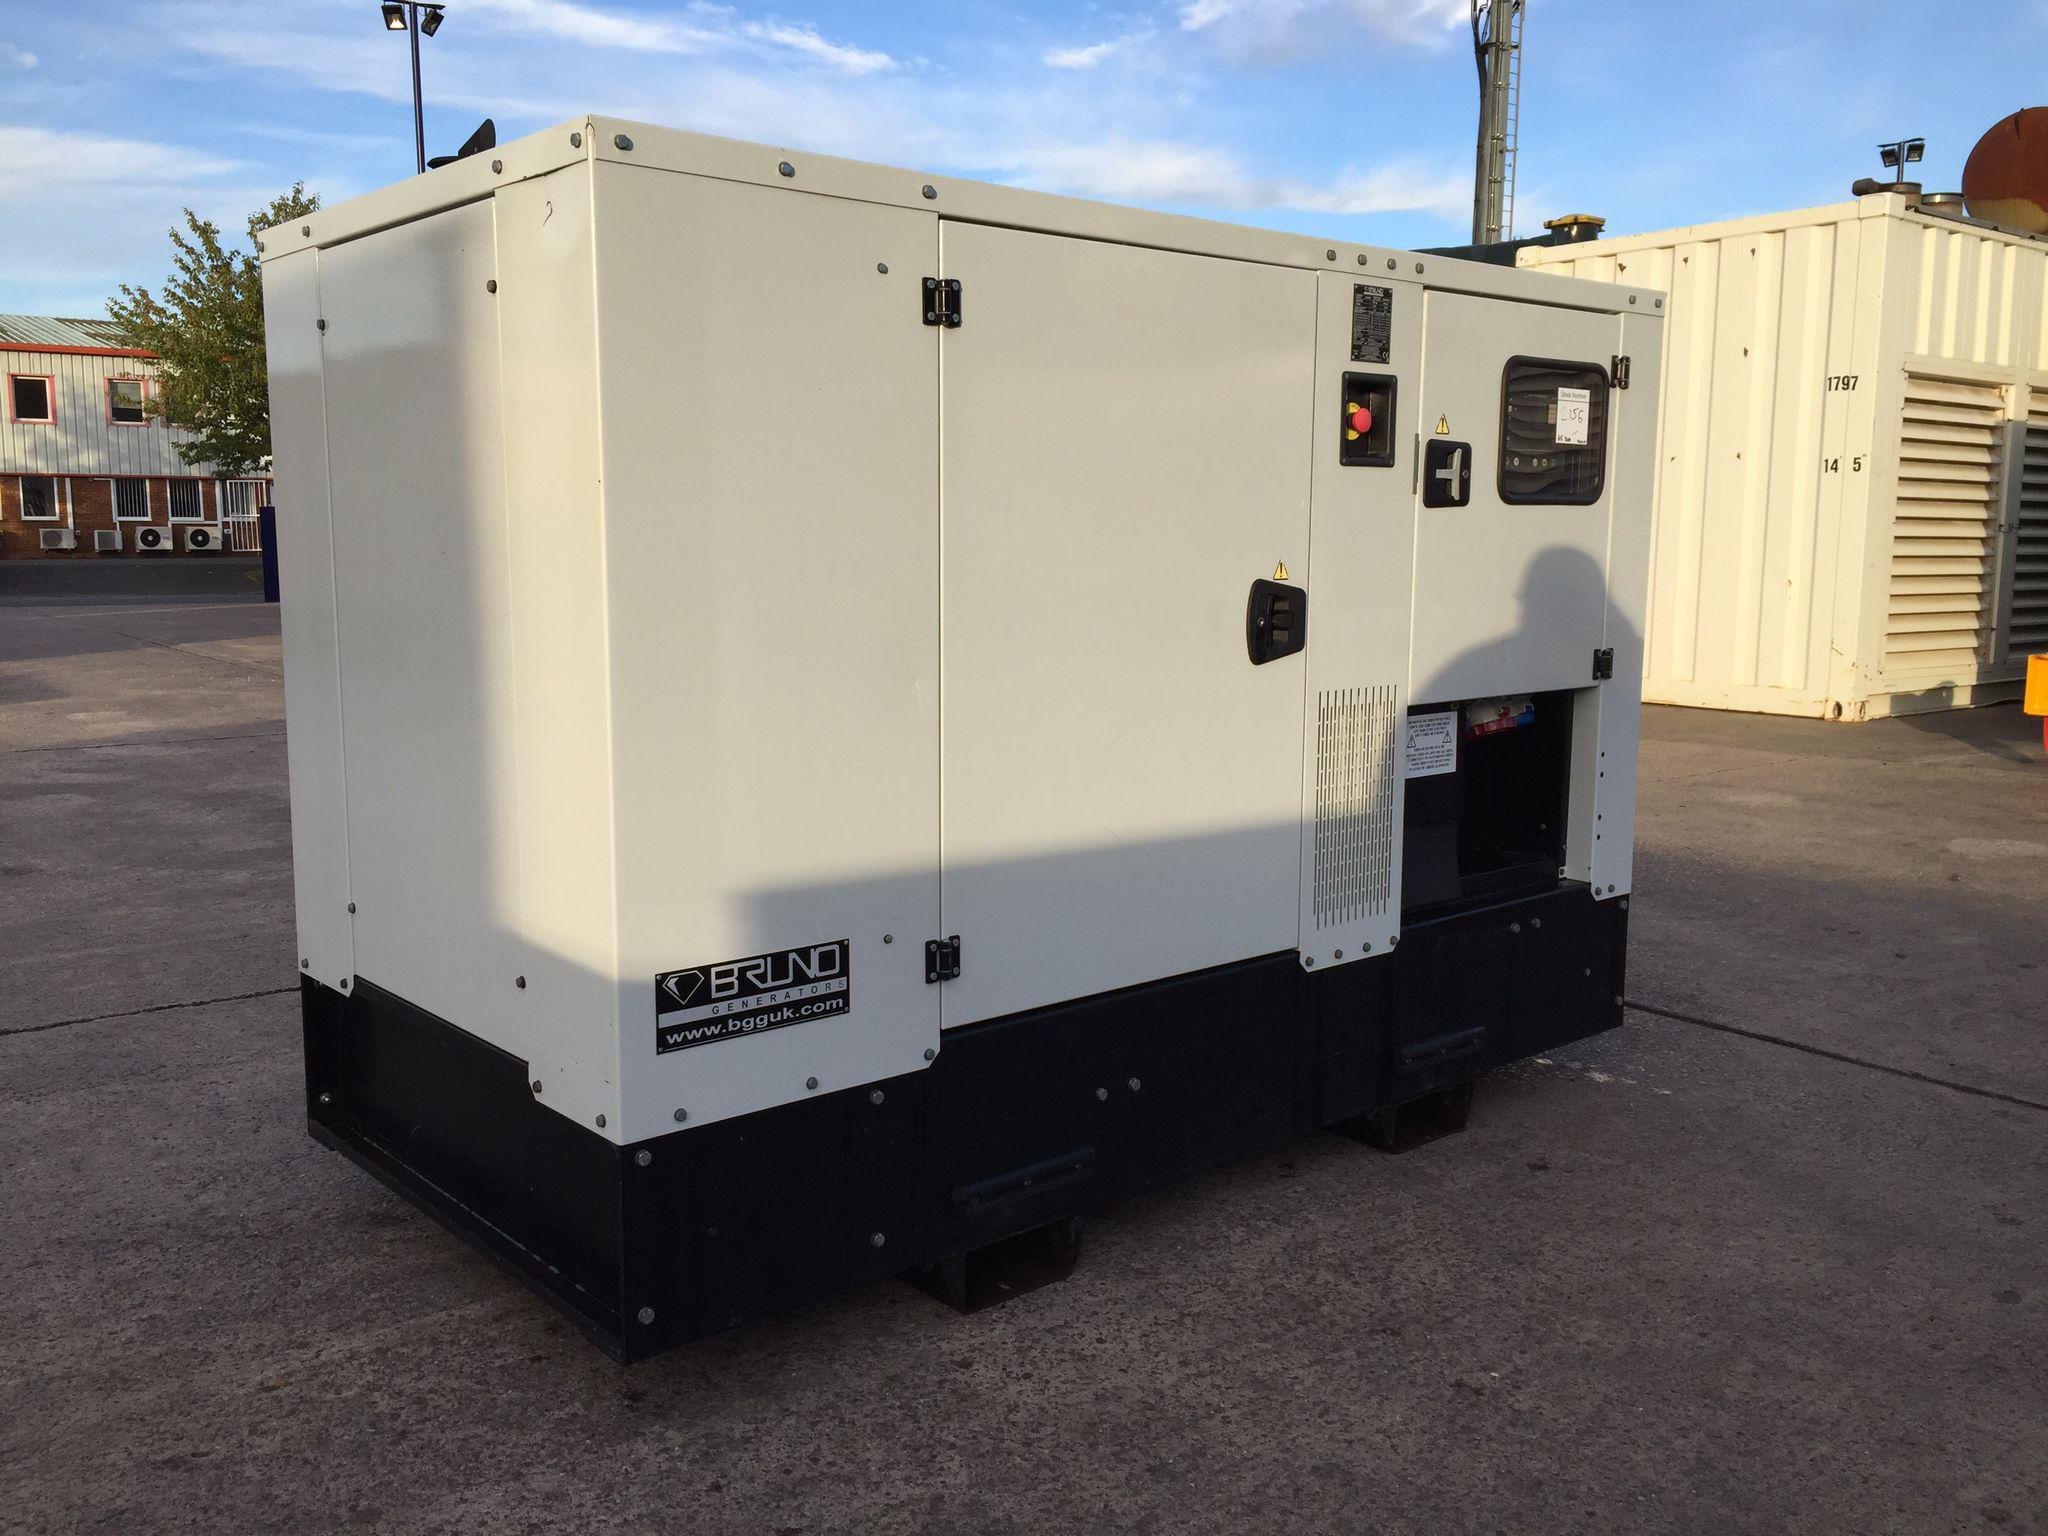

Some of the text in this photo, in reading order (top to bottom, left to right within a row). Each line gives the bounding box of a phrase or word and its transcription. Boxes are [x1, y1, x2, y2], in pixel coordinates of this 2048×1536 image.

[1827, 375, 1859, 391] 1797
[710, 943, 841, 1000] BRUNO
[711, 979, 845, 1015] GENERATORS
[665, 997, 844, 1045] www.bgguk.com
